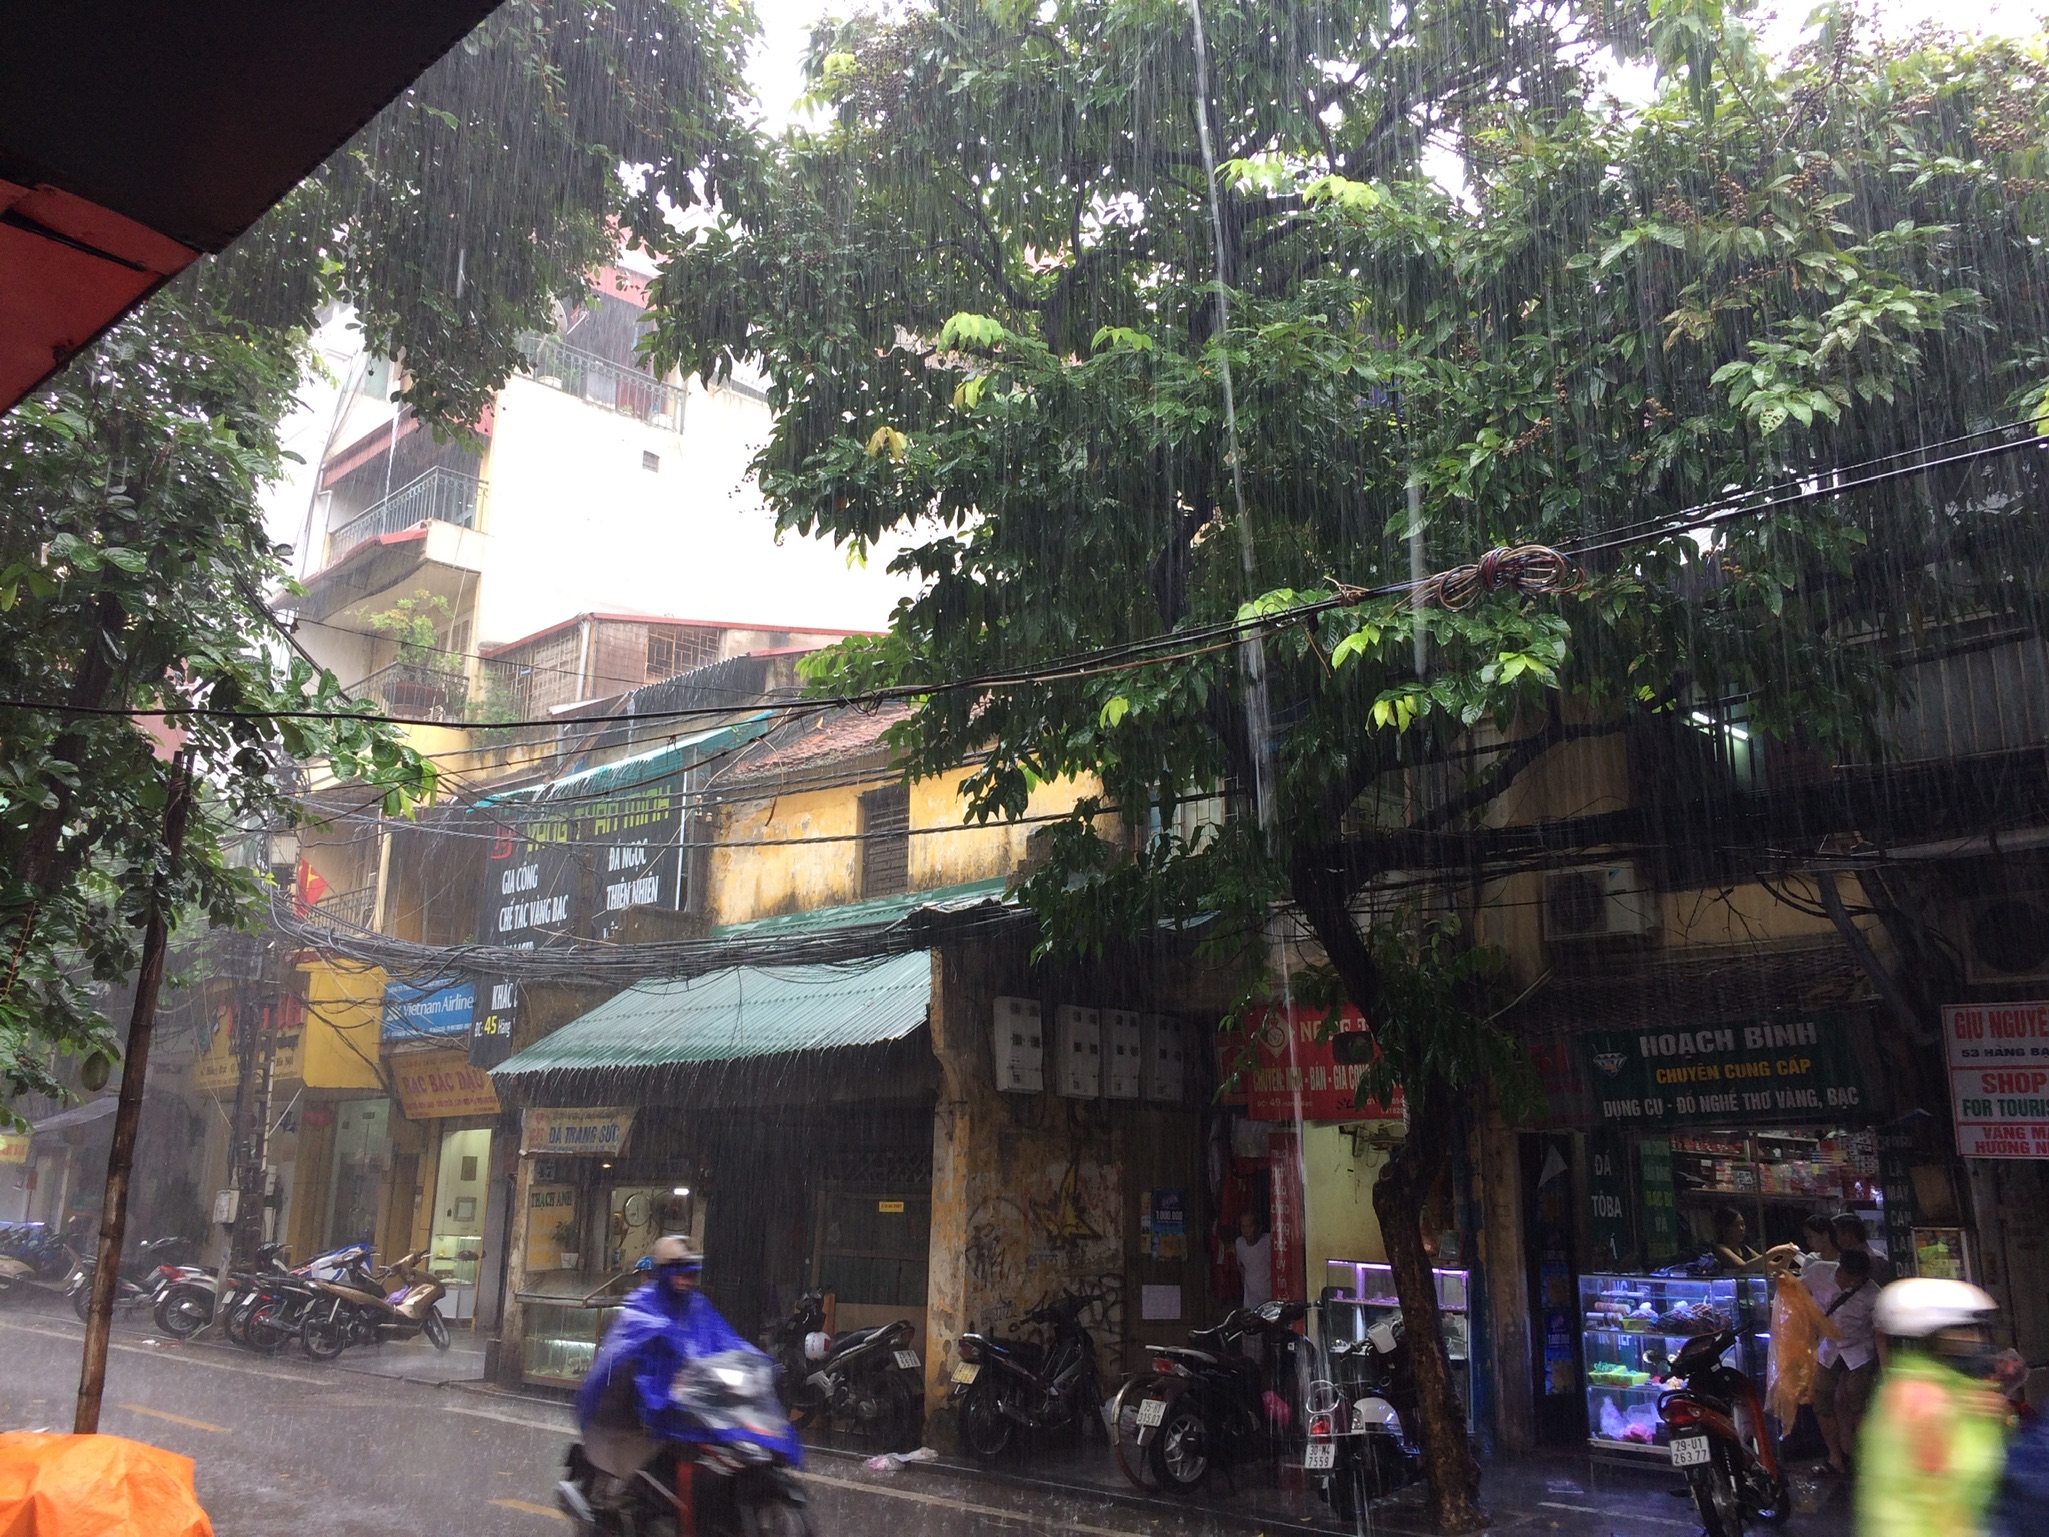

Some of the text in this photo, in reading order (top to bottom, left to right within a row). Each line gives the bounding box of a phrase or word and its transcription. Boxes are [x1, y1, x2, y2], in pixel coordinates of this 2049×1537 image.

[502, 861, 539, 895] GIA CÔNG
[606, 871, 660, 911] THIÊN NHIÊN
[499, 894, 569, 933] CHẾ TÁC VÀNG BẠC
[403, 1001, 441, 1017] Vietnam
[484, 1015, 498, 1035] 45
[1988, 1006, 2049, 1039] NGUYÊ
[1639, 1020, 1818, 1060] HOẠCH BÌNH
[1961, 1049, 1980, 1058] 53
[1984, 1044, 2025, 1057] HÀNG
[1309, 1061, 1328, 1091] BÁN
[1333, 1064, 1348, 1091] GIA
[1655, 1054, 1811, 1085] CHUYÊN CUNG CẤP
[1982, 1072, 2047, 1094] SHOP
[1269, 1097, 1281, 1107] 49
[1603, 1098, 1641, 1120] DỤNG
[1644, 1097, 1665, 1119] CỤ
[1826, 1086, 1860, 1109] BẠC
[1962, 1098, 1993, 1117] FOR
[565, 1126, 597, 1144] TRANG
[1594, 1149, 1612, 1177] ĐÁ
[531, 1191, 555, 1211] THẠCH
[1591, 1189, 1623, 1218] TÔBA
[1675, 1438, 1703, 1452] 29-U1
[1308, 1456, 1329, 1467] 7559
